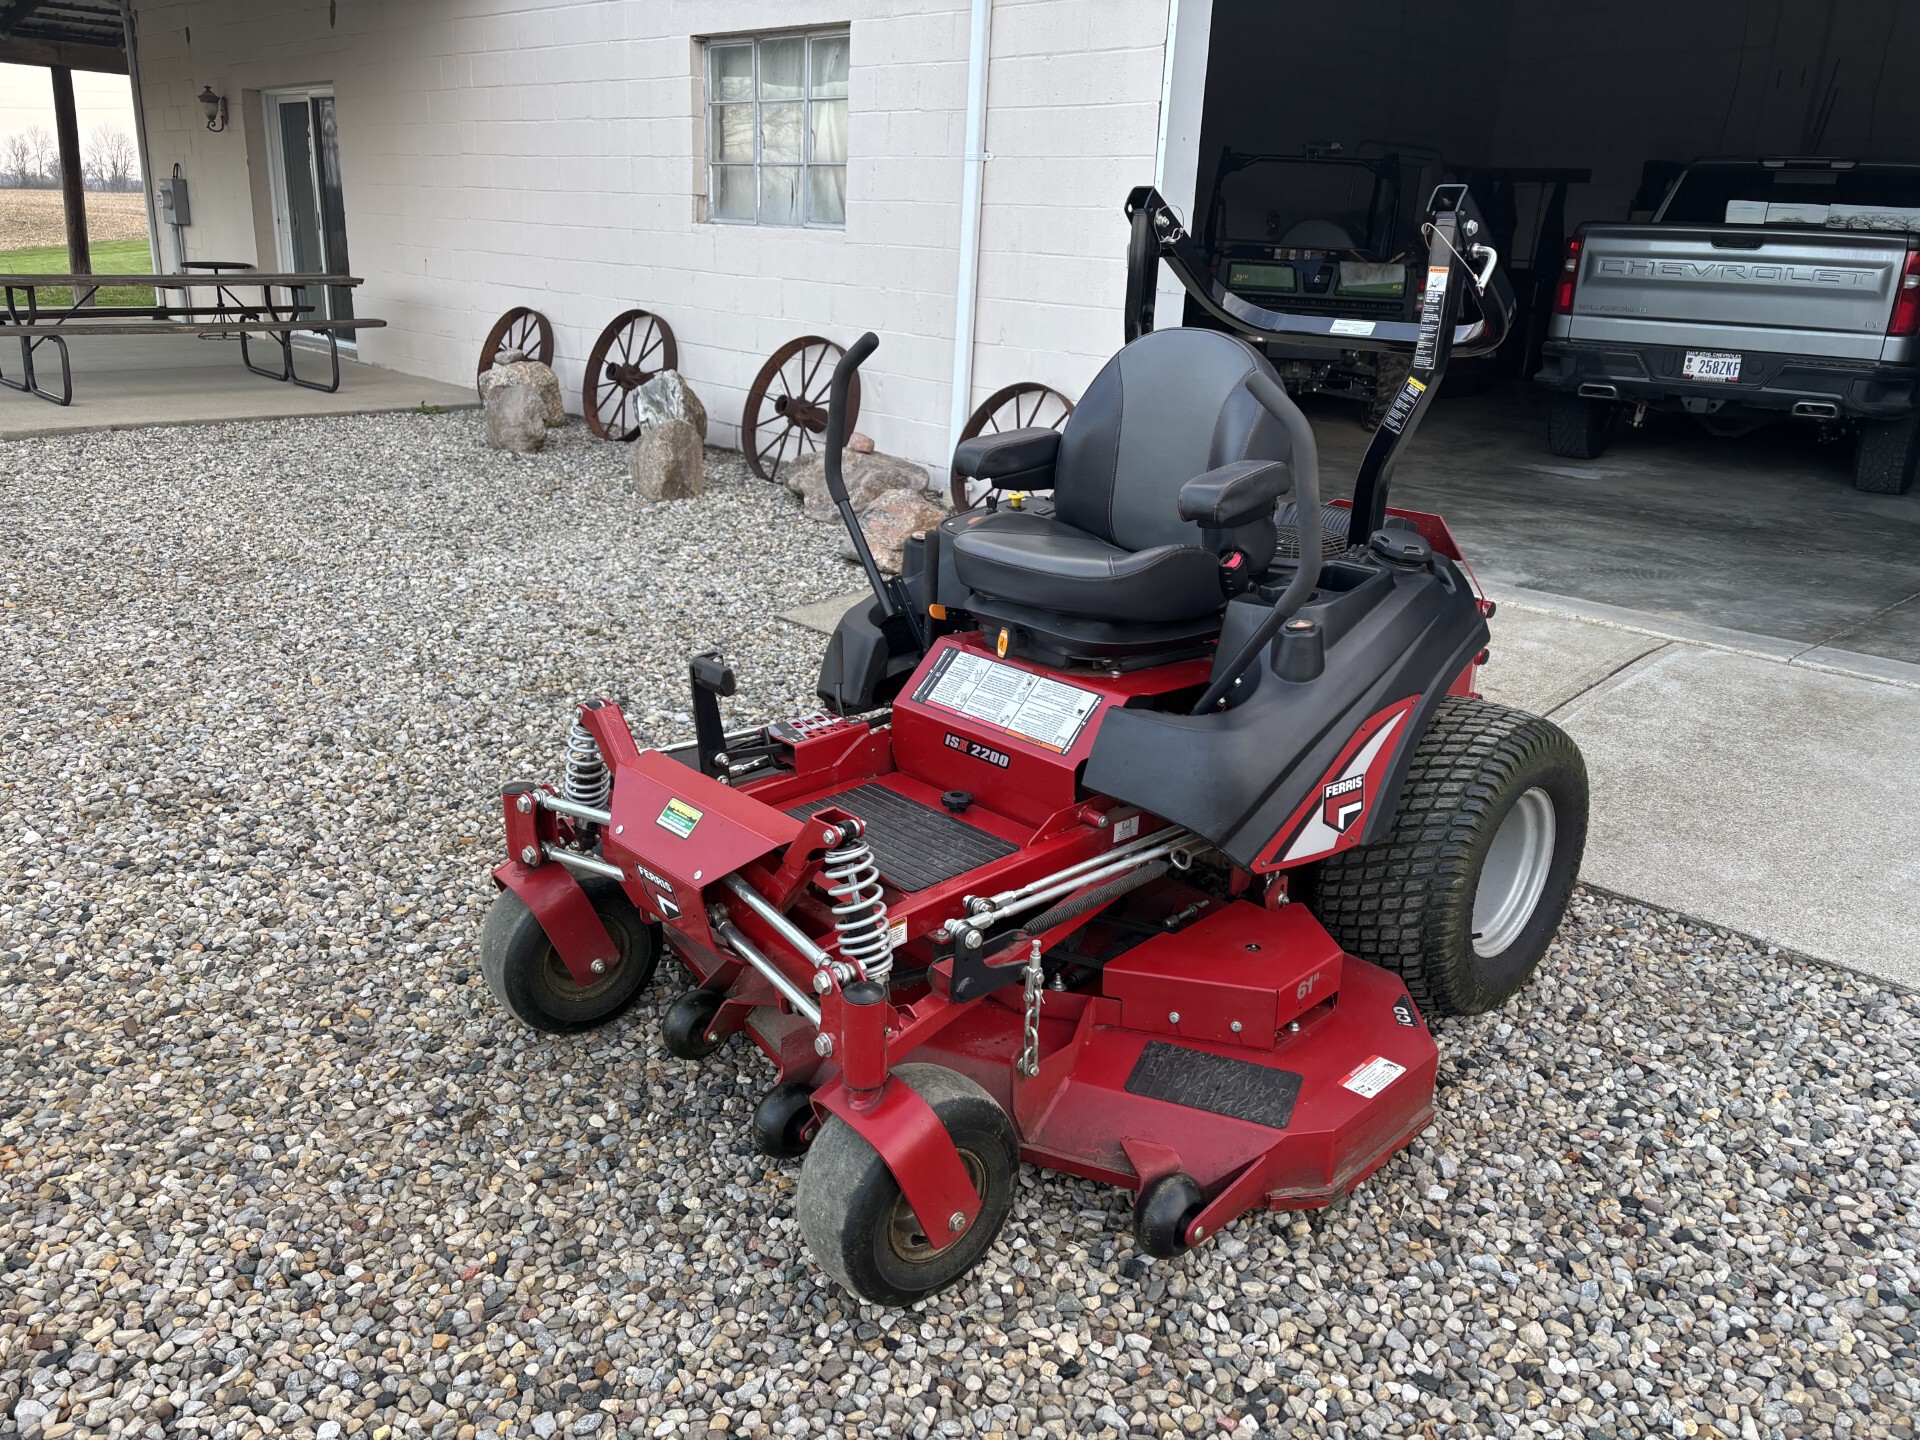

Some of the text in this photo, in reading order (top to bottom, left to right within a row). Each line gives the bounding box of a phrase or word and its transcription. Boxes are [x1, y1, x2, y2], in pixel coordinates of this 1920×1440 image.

[1598, 258, 1876, 288] CHEVROLET
[1698, 359, 1741, 376] 258ZKF
[945, 733, 1010, 768] ISX 2200
[1325, 776, 1363, 798] FERRIS
[637, 864, 672, 892] FERRIS
